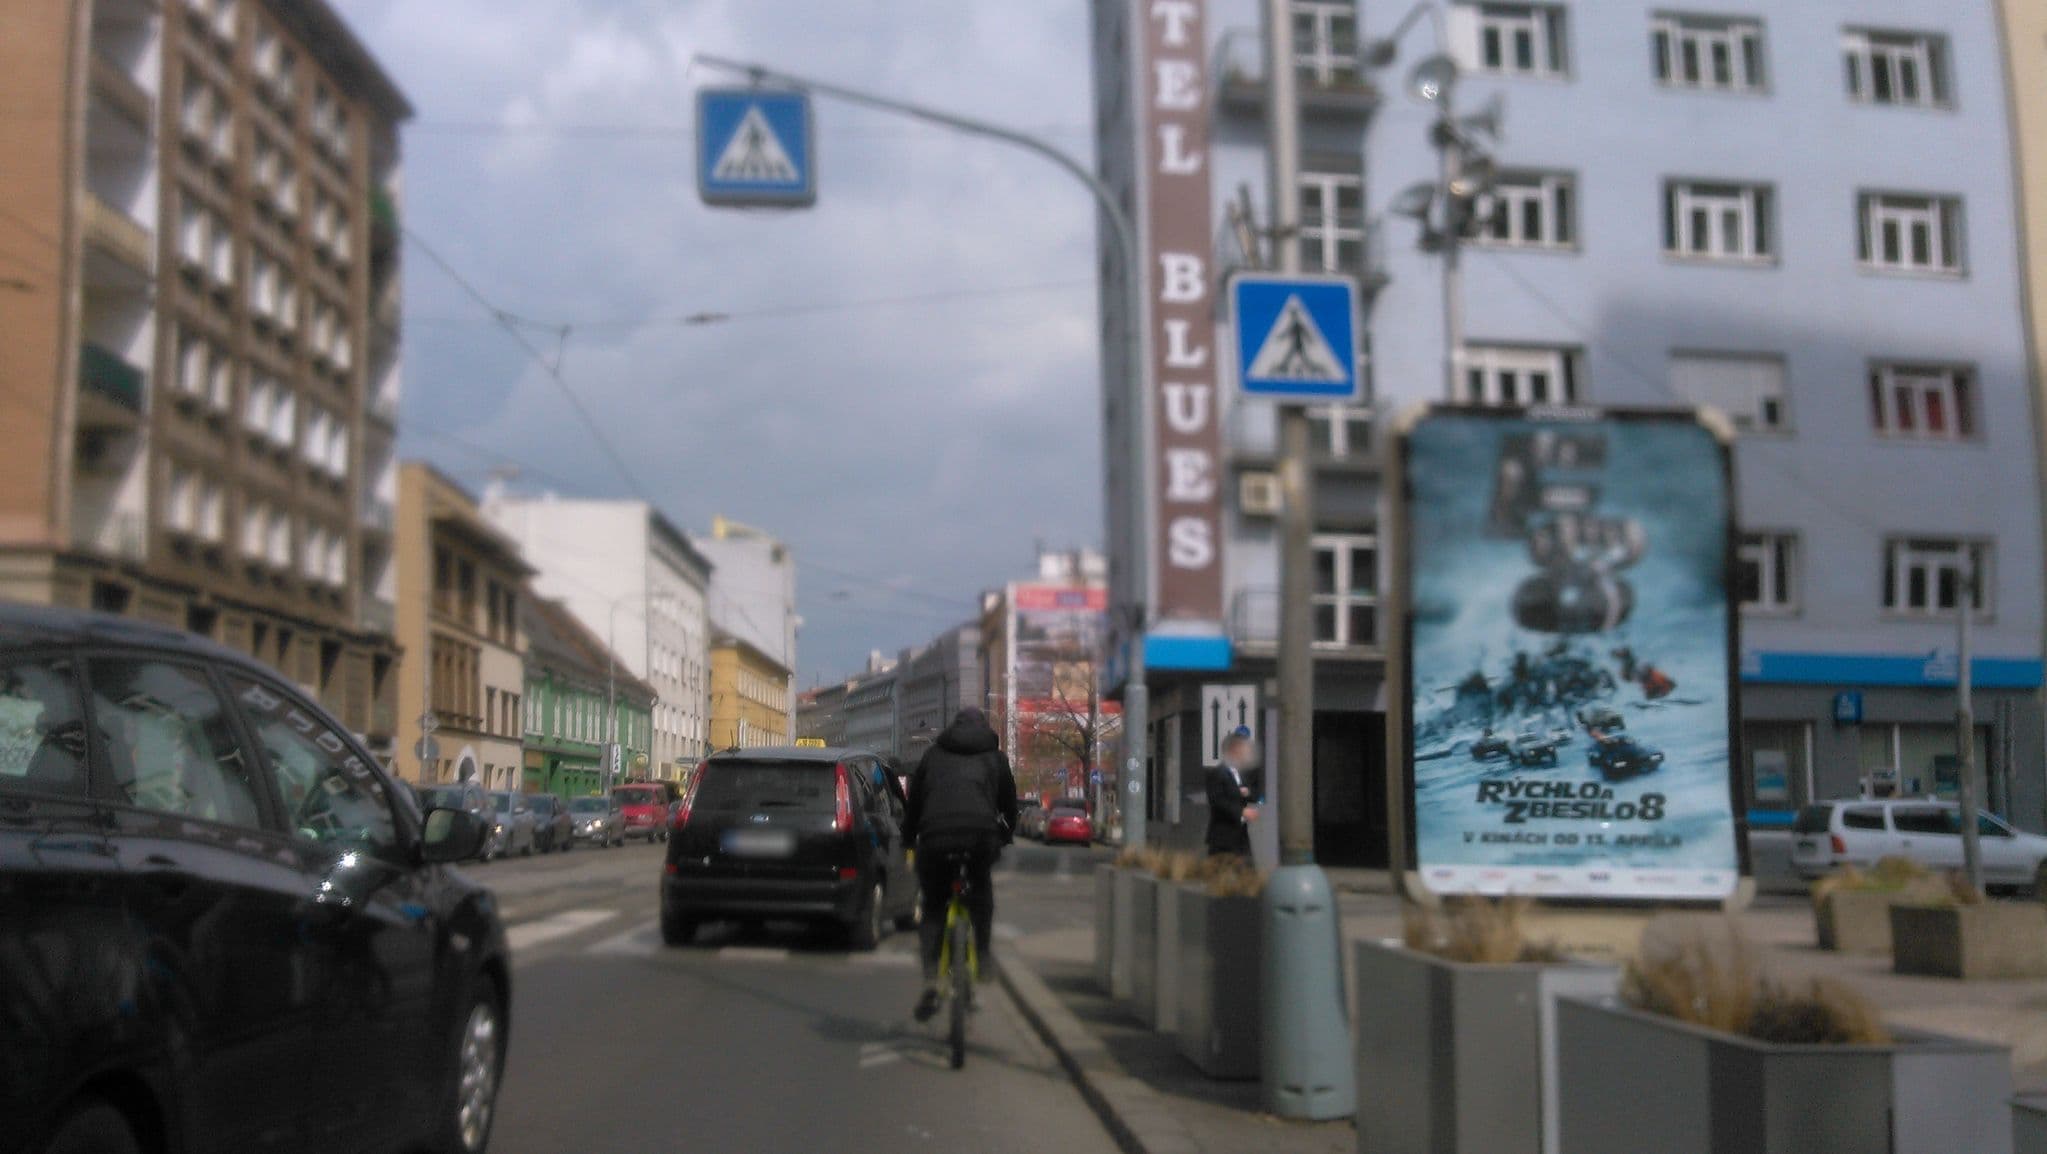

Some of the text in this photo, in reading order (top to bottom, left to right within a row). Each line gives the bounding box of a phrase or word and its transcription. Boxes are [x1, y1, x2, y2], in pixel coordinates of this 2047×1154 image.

[1160, 252, 1215, 569] BLUES
[1477, 777, 1600, 802] RÝCHLO
[1503, 801, 1637, 823] ZBESILO
[1463, 831, 1474, 843] V
[1480, 830, 1547, 844] KINÁCH
[1554, 832, 1579, 845] OD
